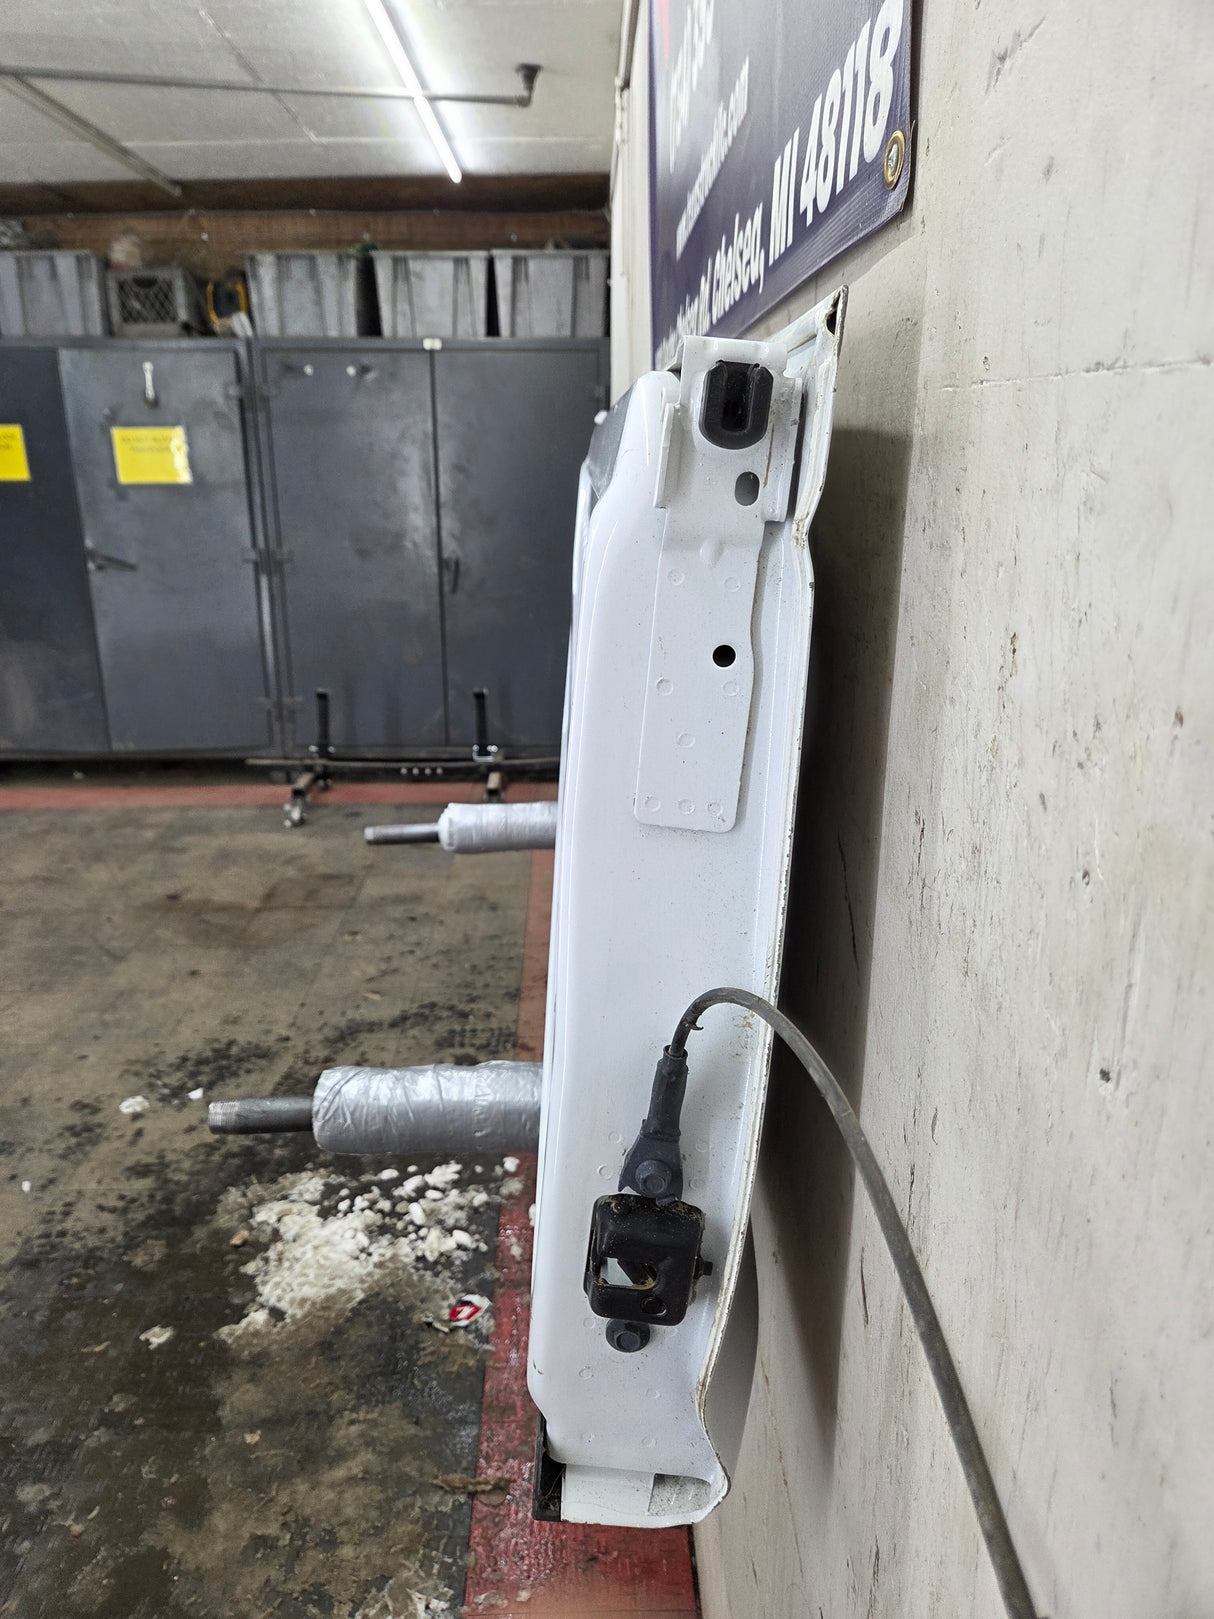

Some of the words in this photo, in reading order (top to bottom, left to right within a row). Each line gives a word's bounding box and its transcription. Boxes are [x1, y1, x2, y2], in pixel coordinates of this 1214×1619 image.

[712, 202, 765, 326] Chelsea,
[769, 126, 800, 268] MI
[800, 0, 904, 228] 48118
